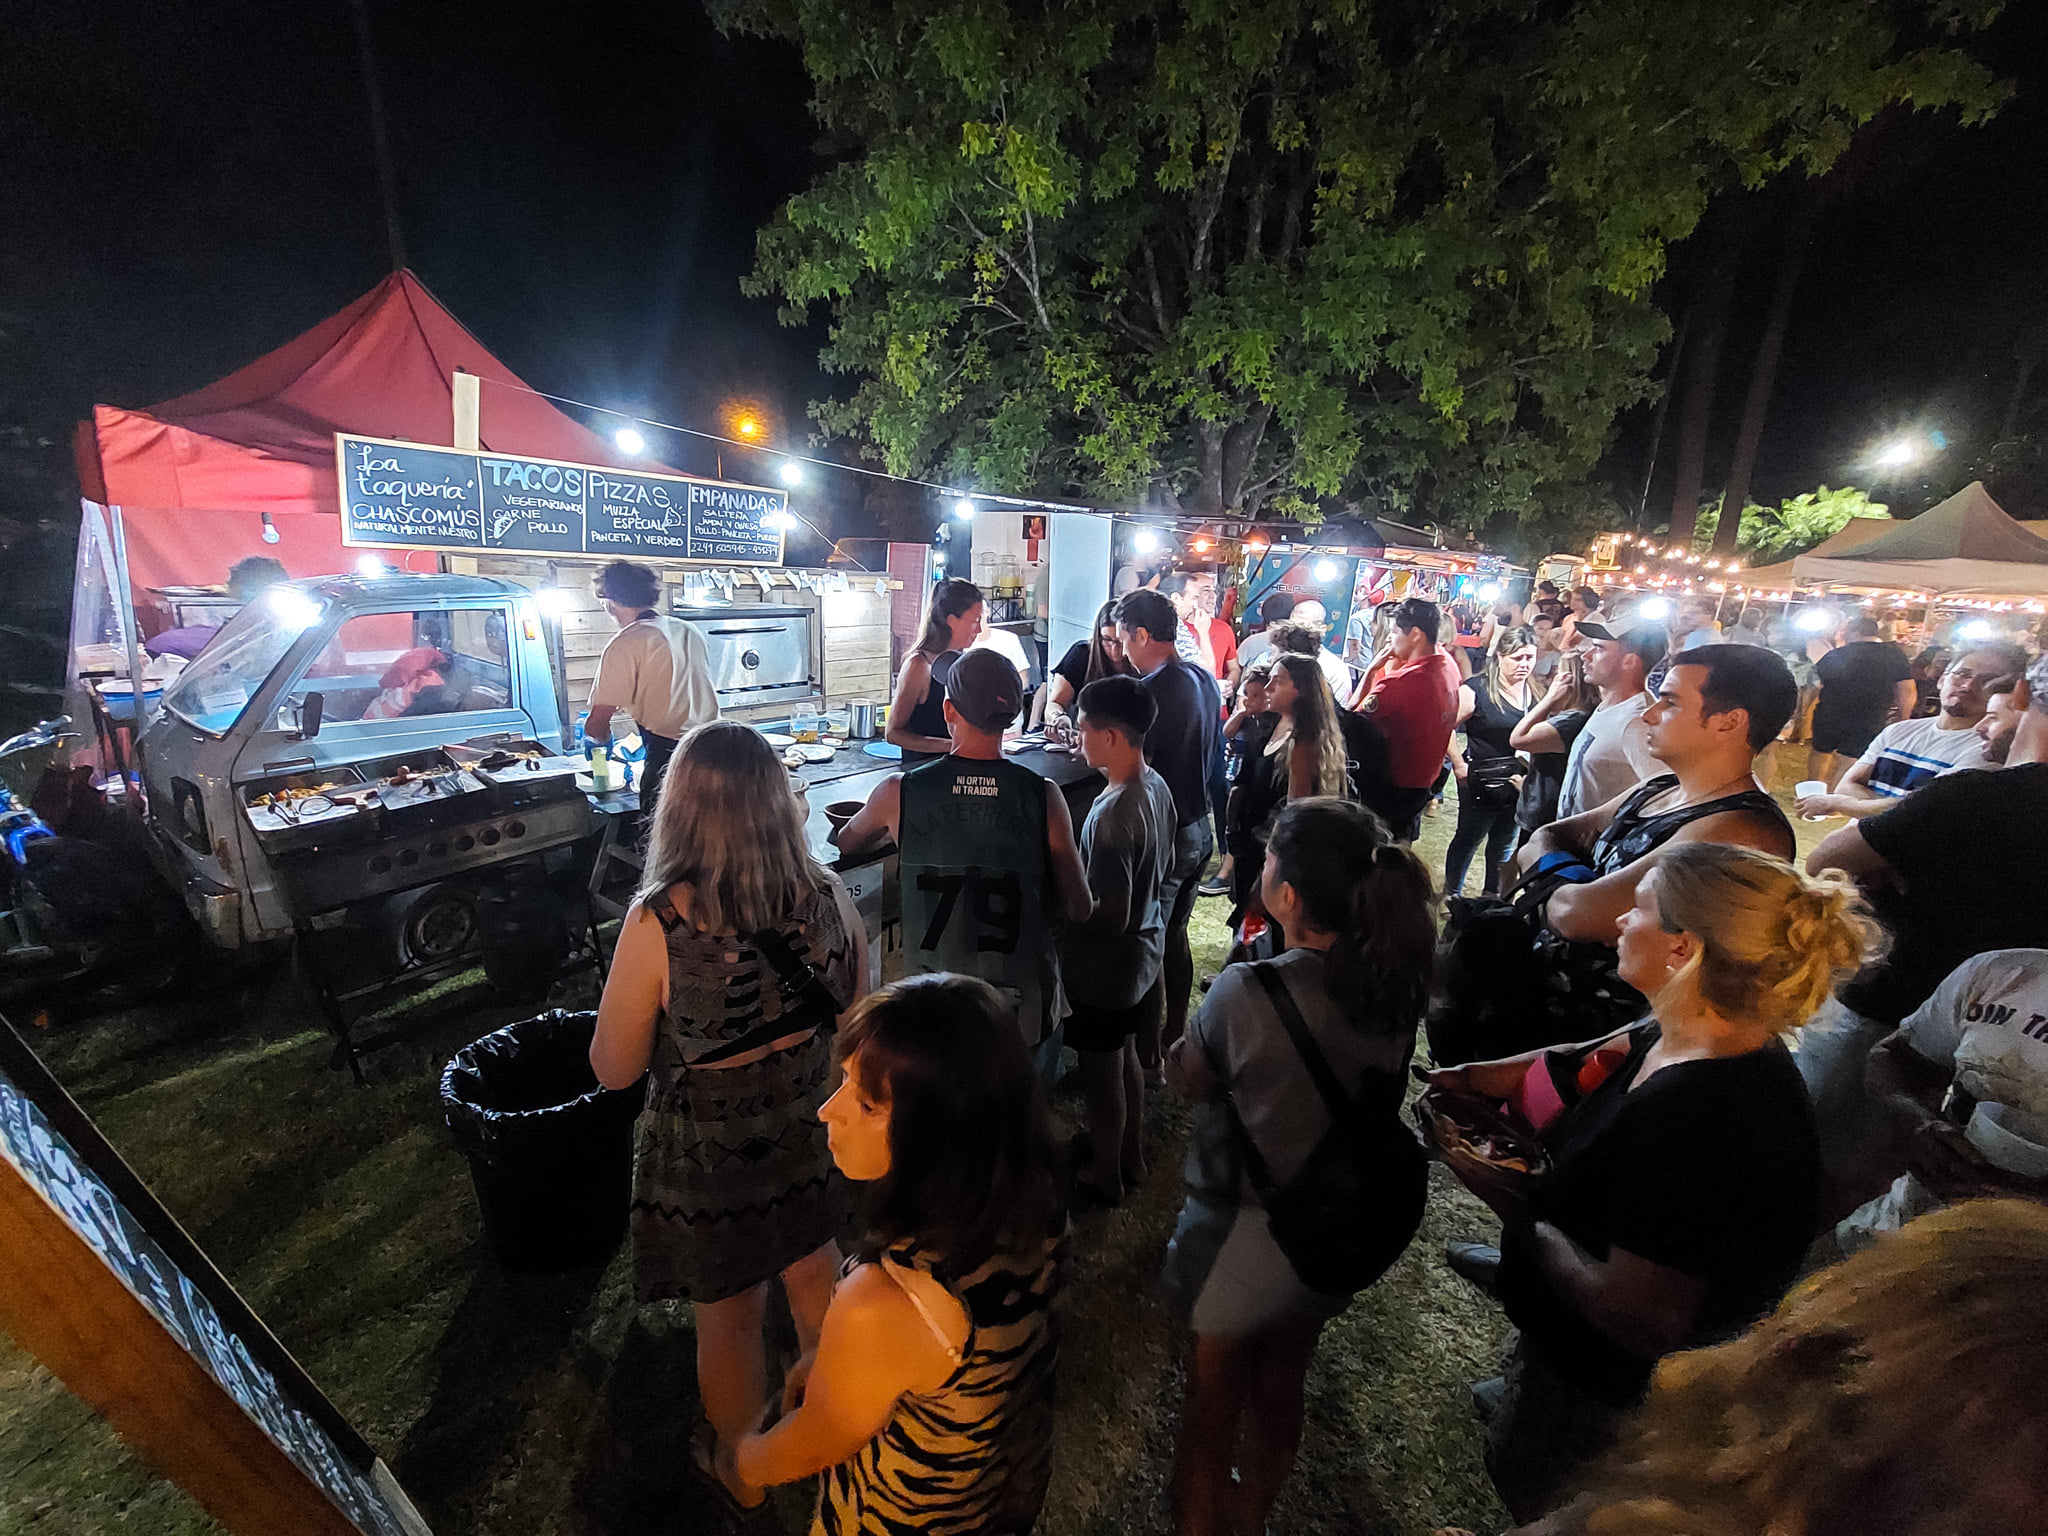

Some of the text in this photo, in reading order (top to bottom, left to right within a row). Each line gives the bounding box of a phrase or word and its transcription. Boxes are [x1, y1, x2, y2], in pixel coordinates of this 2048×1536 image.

[482, 460, 582, 496] TACOS
[589, 472, 671, 508] PIZZAS
[503, 494, 584, 515] VEGETARIANOS
[691, 487, 778, 514] EMPANADAS
[603, 504, 640, 519] MUZZA
[354, 522, 478, 540] NATURALMENTE NUESTRO
[528, 521, 568, 534] POLLO
[613, 518, 665, 531] ESPECIAL
[591, 530, 684, 547] PANCETA Y VERDEO
[691, 542, 713, 555] 2241
[1271, 583, 1327, 595] HELADOS
[956, 775, 996, 786] NI ORTIVA
[952, 785, 999, 797] NI TRAIDOR
[916, 872, 1022, 954] 79
